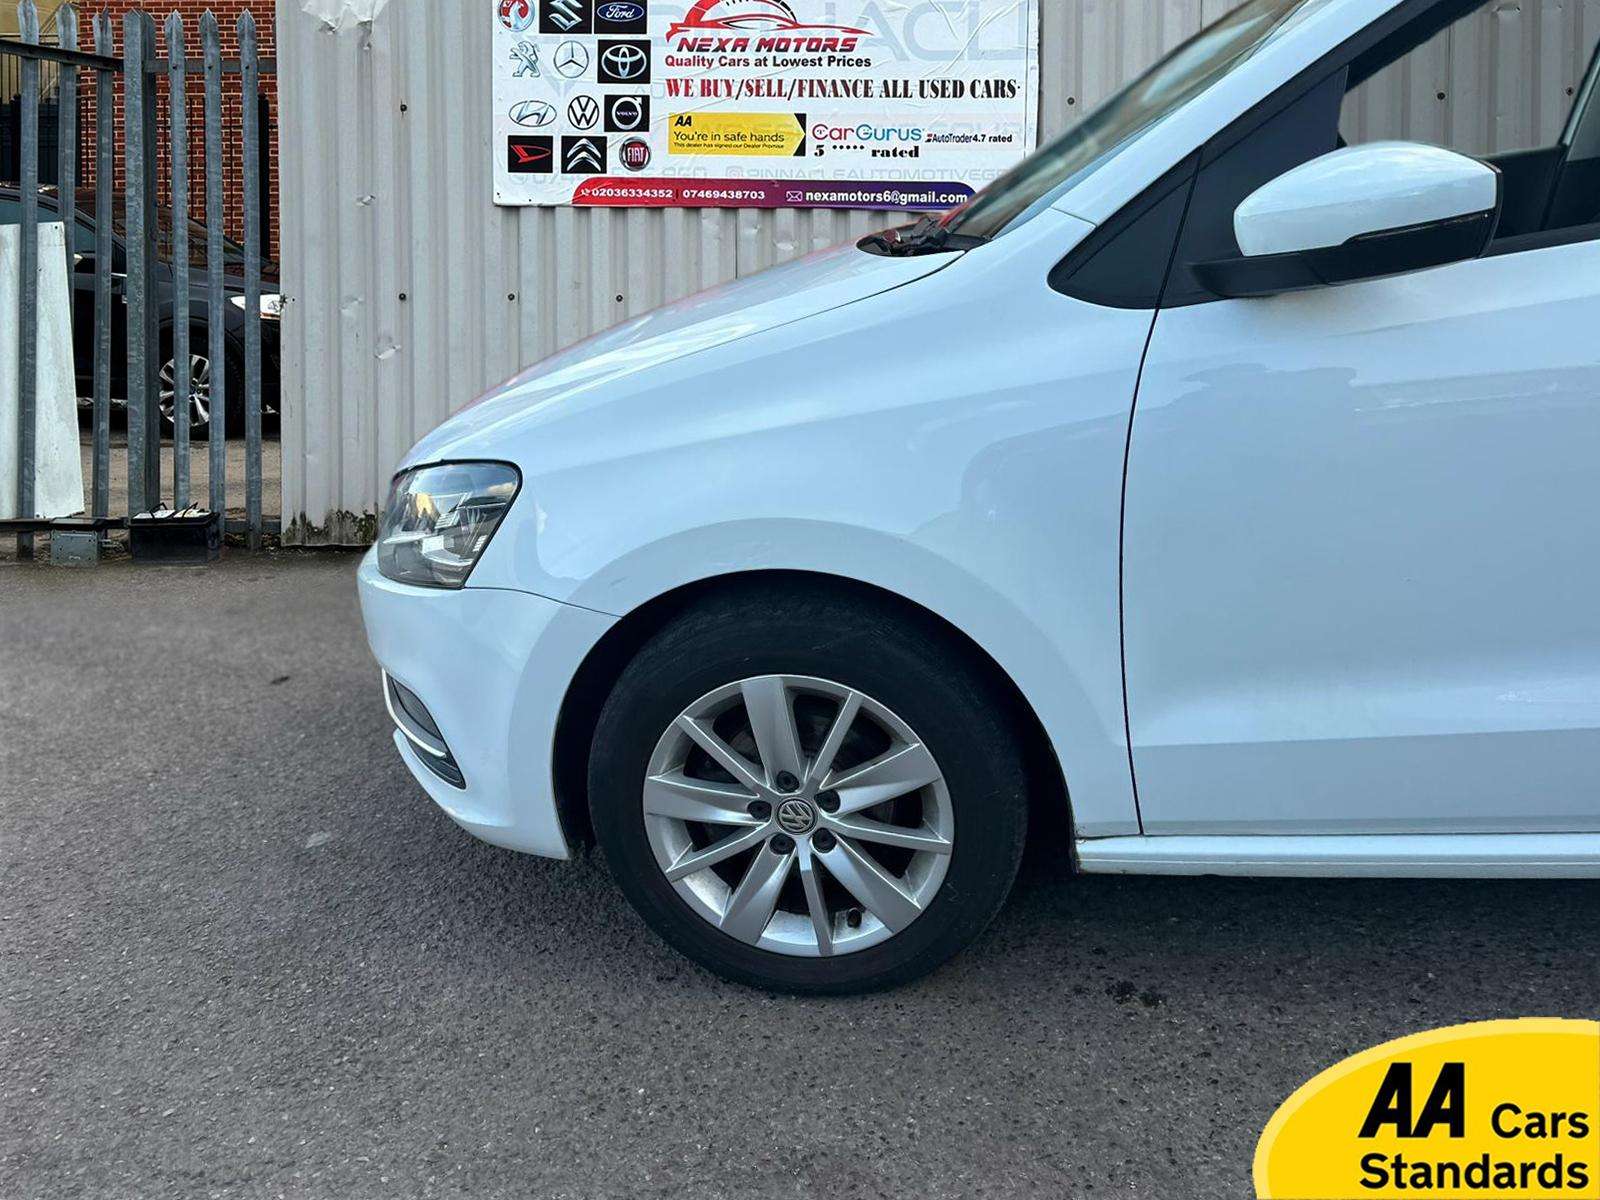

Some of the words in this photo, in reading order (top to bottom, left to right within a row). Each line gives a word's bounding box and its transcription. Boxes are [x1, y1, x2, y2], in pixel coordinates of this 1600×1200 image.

[606, 4, 635, 19] Ford
[677, 37, 750, 53] NEXA
[755, 37, 858, 53] MOTORS
[665, 55, 714, 69] Quality
[718, 55, 750, 68] Cars
[754, 56, 768, 68] at
[773, 55, 823, 68] Lowest
[827, 55, 872, 68] Prices
[665, 78, 694, 98] WE
[879, 79, 913, 99] ALL
[918, 79, 965, 99] USED
[674, 115, 692, 127] AA
[673, 131, 709, 141] You're
[711, 131, 721, 141] in
[724, 131, 748, 142] safe
[750, 131, 785, 142] hands
[812, 123, 922, 142] CarGurus
[988, 134, 1013, 143] rated
[627, 146, 645, 163] FIAT
[814, 144, 825, 157] 5
[871, 145, 920, 158] rated
[592, 189, 673, 199] 02036334352
[682, 189, 766, 200] 07469438703
[805, 190, 968, 206] nexamotors6@gmail.com
